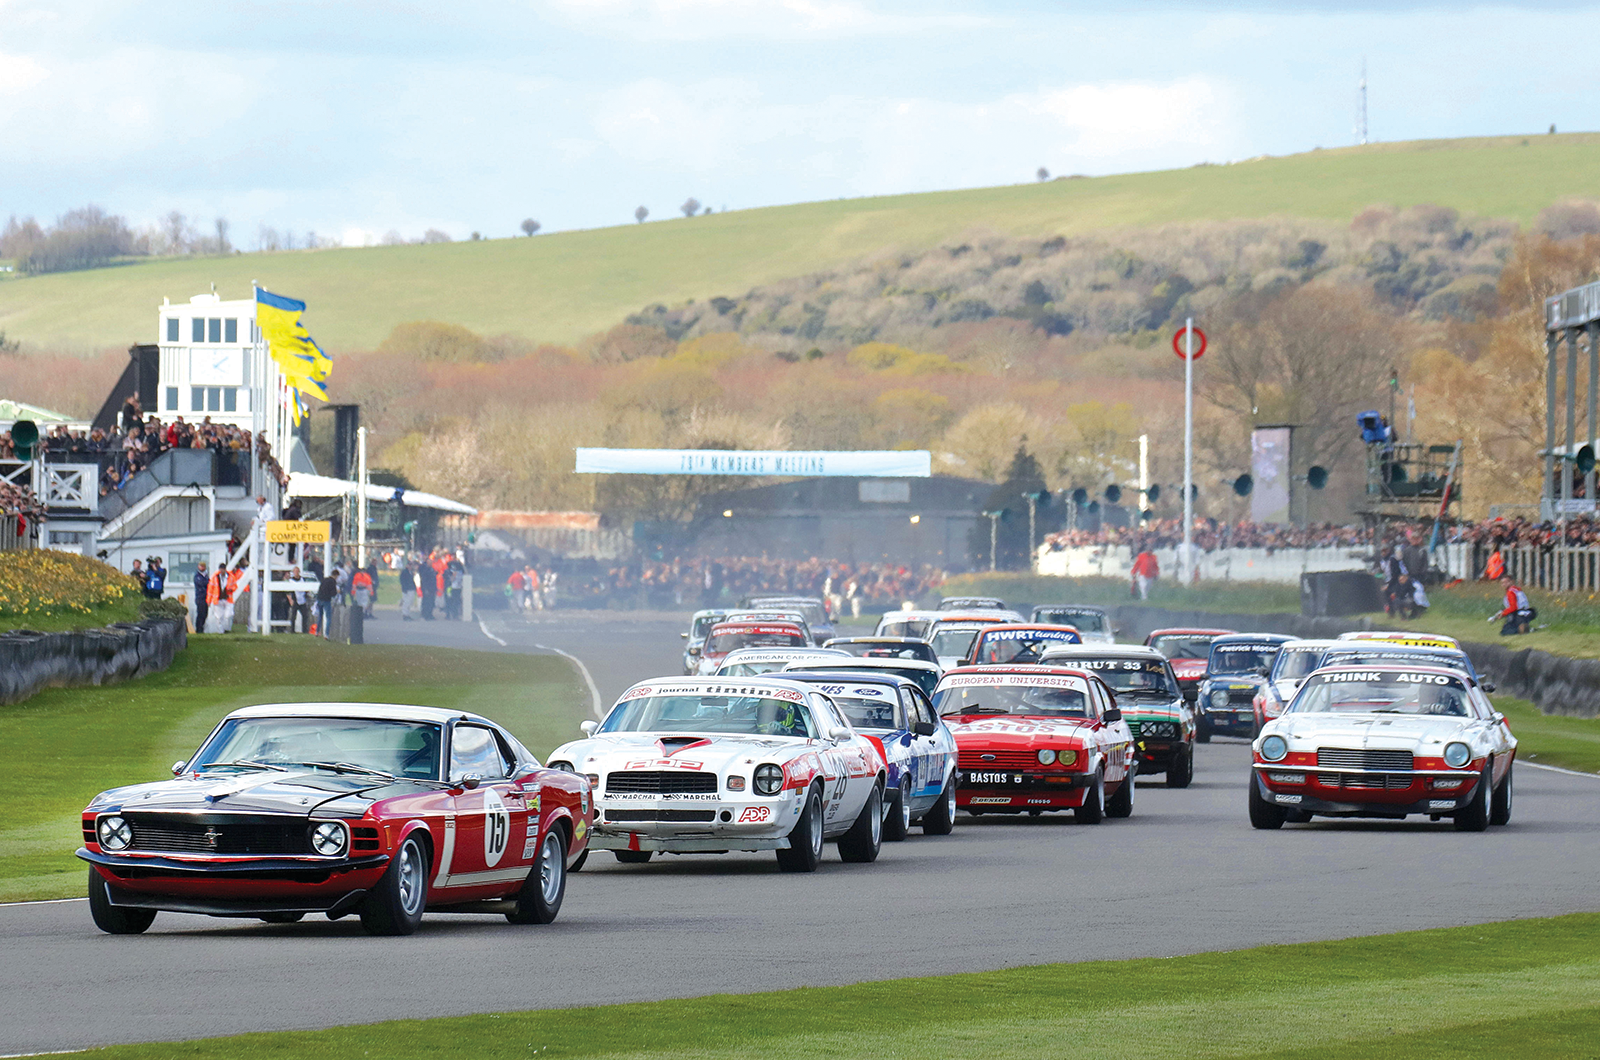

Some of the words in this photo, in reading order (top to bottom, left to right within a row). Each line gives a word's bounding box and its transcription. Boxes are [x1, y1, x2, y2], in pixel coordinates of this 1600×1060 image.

[775, 456, 825, 473] MEETING
[286, 523, 309, 531] LAPS
[271, 533, 324, 542] COMPLETED
[987, 630, 1035, 642] HWRT
[1035, 630, 1075, 643] tuning
[1065, 661, 1118, 671] BRUT
[1123, 661, 1142, 671] 33
[950, 676, 1003, 686] EUROPEAN
[1009, 676, 1076, 687] UNIVERSITY
[1321, 672, 1382, 684] THINK
[1395, 673, 1450, 686] AUTO
[624, 686, 652, 700] ADP
[656, 685, 700, 694] journal
[706, 685, 772, 696] tintin
[773, 689, 803, 701] ADP
[627, 758, 702, 769] ADP
[970, 772, 1007, 784] BASTOS
[682, 793, 722, 801] MARCHAL
[738, 806, 771, 823] ADP
[488, 804, 506, 854] 15
